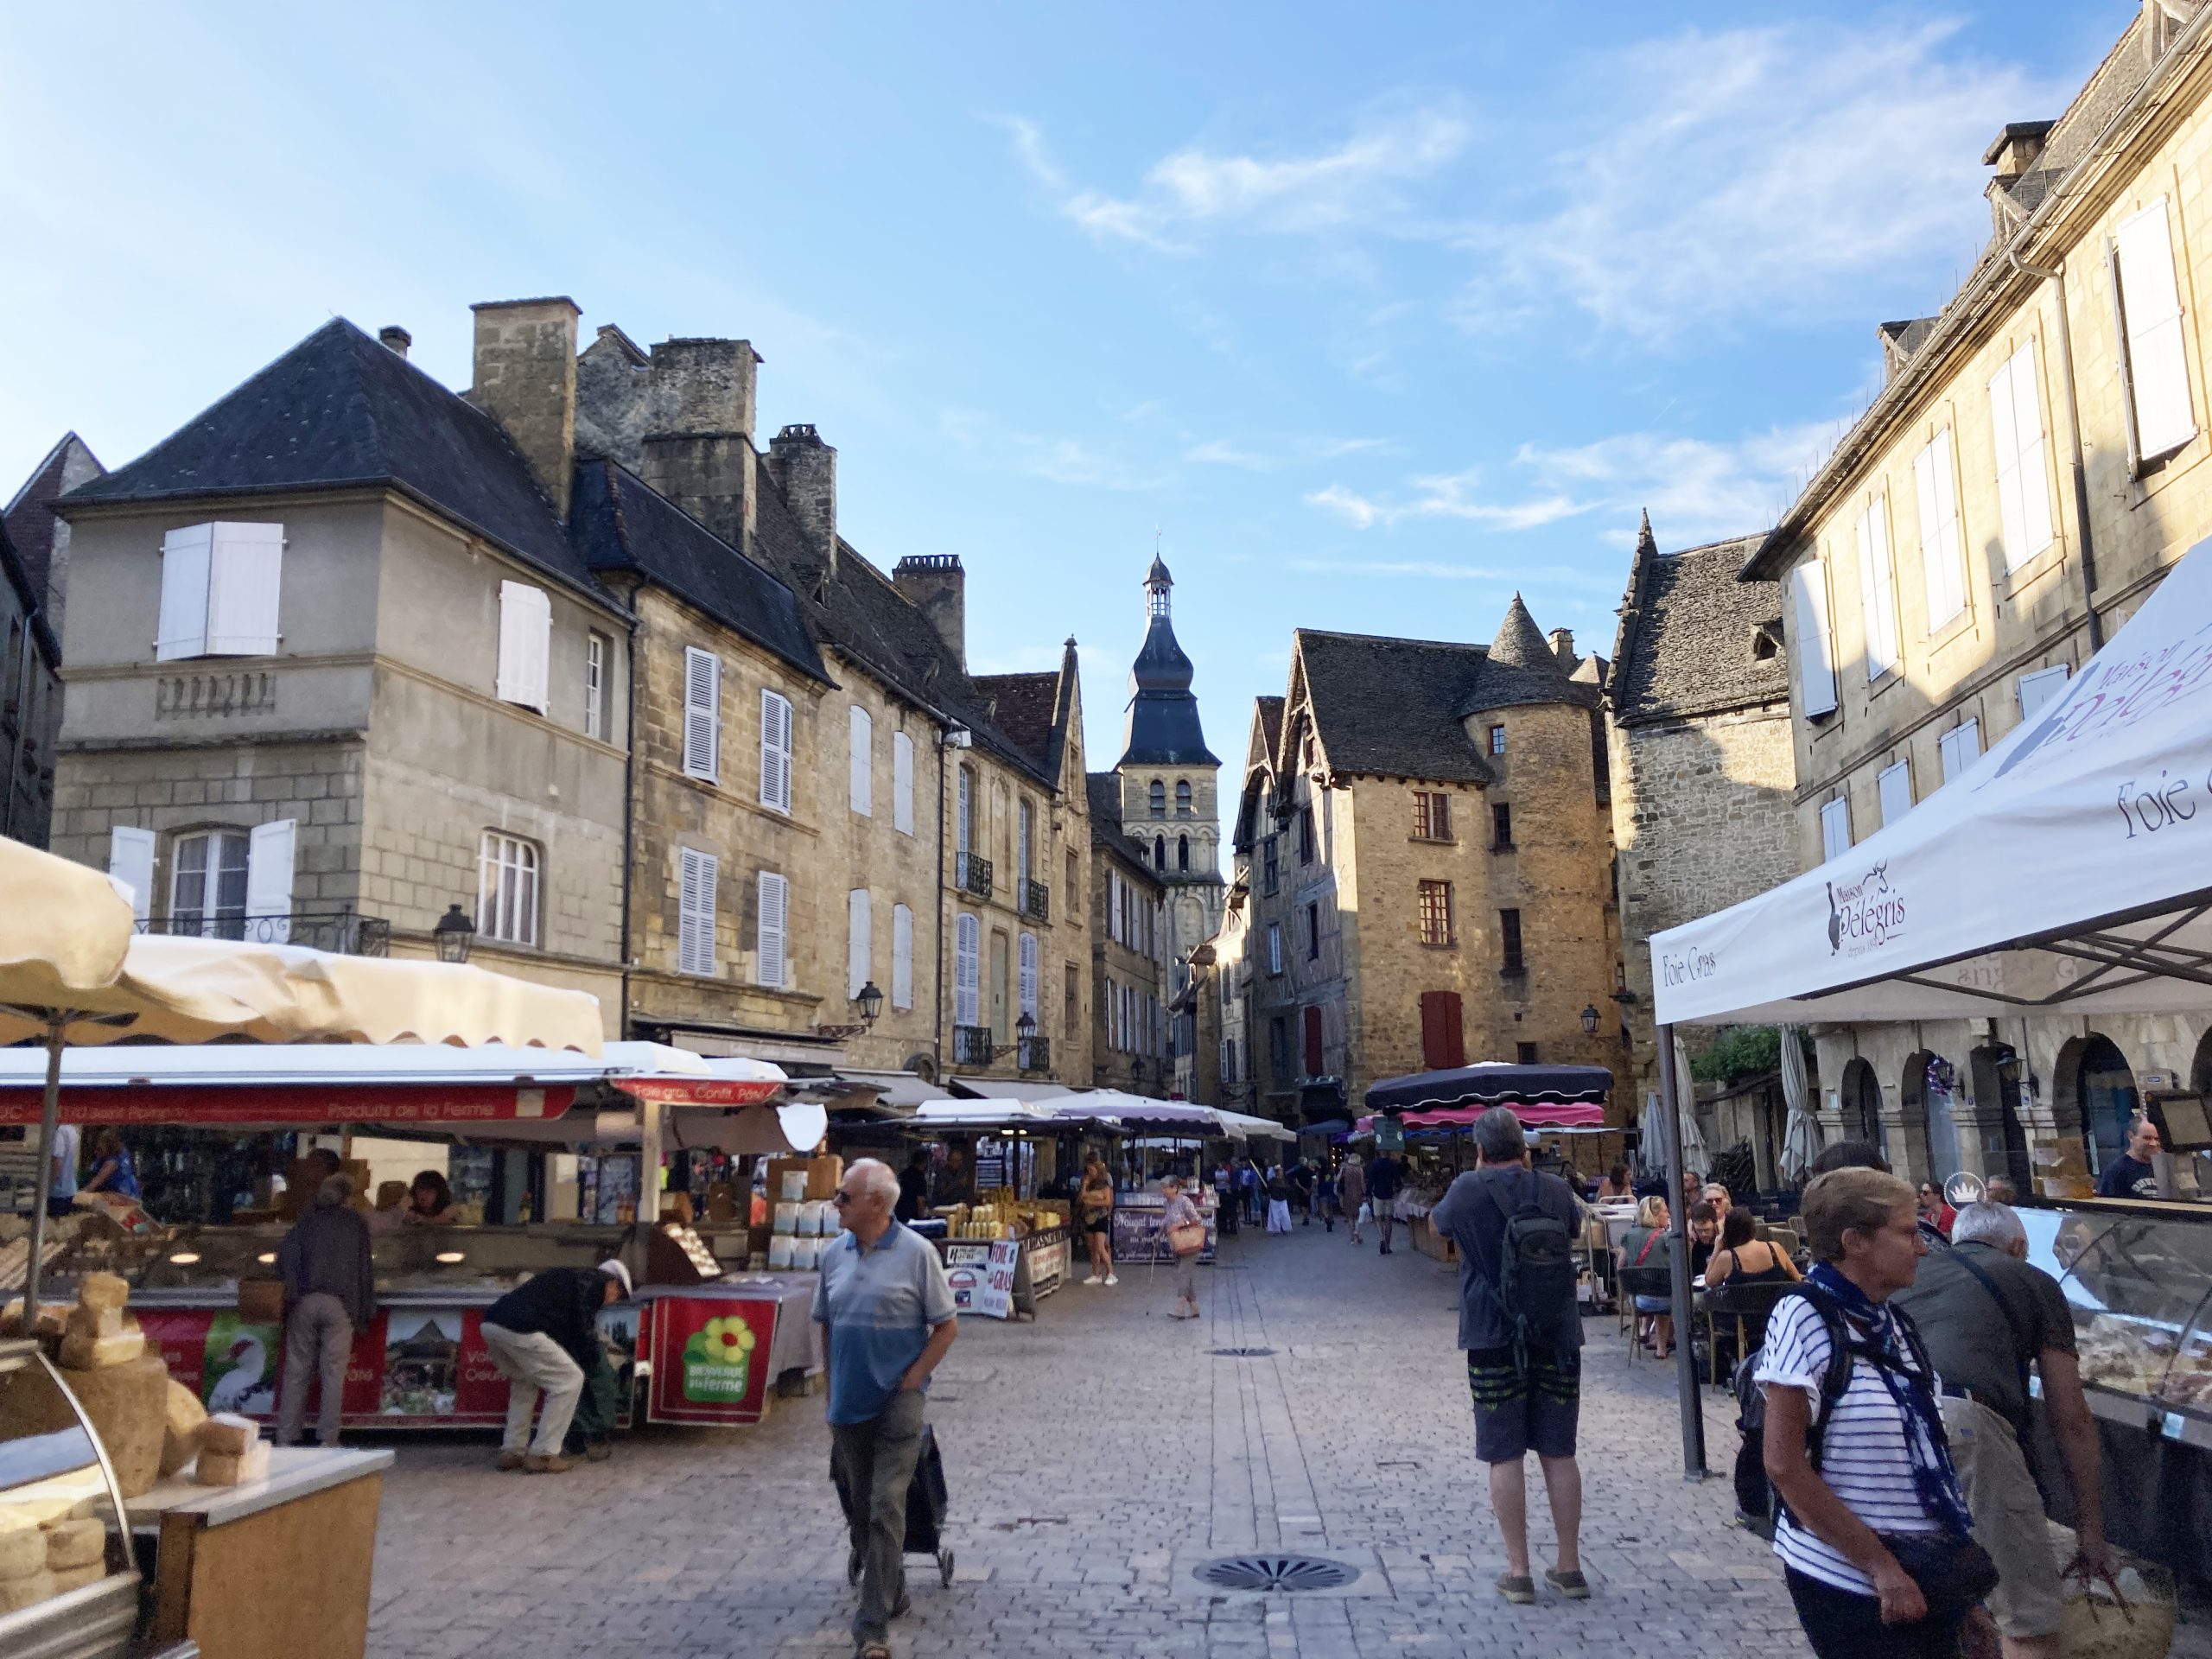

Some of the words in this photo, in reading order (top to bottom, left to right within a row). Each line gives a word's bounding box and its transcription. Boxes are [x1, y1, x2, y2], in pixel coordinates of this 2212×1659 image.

[2117, 770, 2196, 839] Foie
[1837, 885, 1864, 904] Maison
[1662, 954, 1686, 987] Foie
[1688, 946, 1716, 980] Gras
[635, 1085, 661, 1097] Foie
[327, 1102, 391, 1118] Produits
[396, 1103, 417, 1117] de
[423, 1103, 438, 1117] la
[443, 1102, 495, 1117] Ferme
[1114, 1211, 1147, 1234] Nougat
[992, 1244, 1008, 1265] FOIE
[994, 1269, 1014, 1291] GRAS
